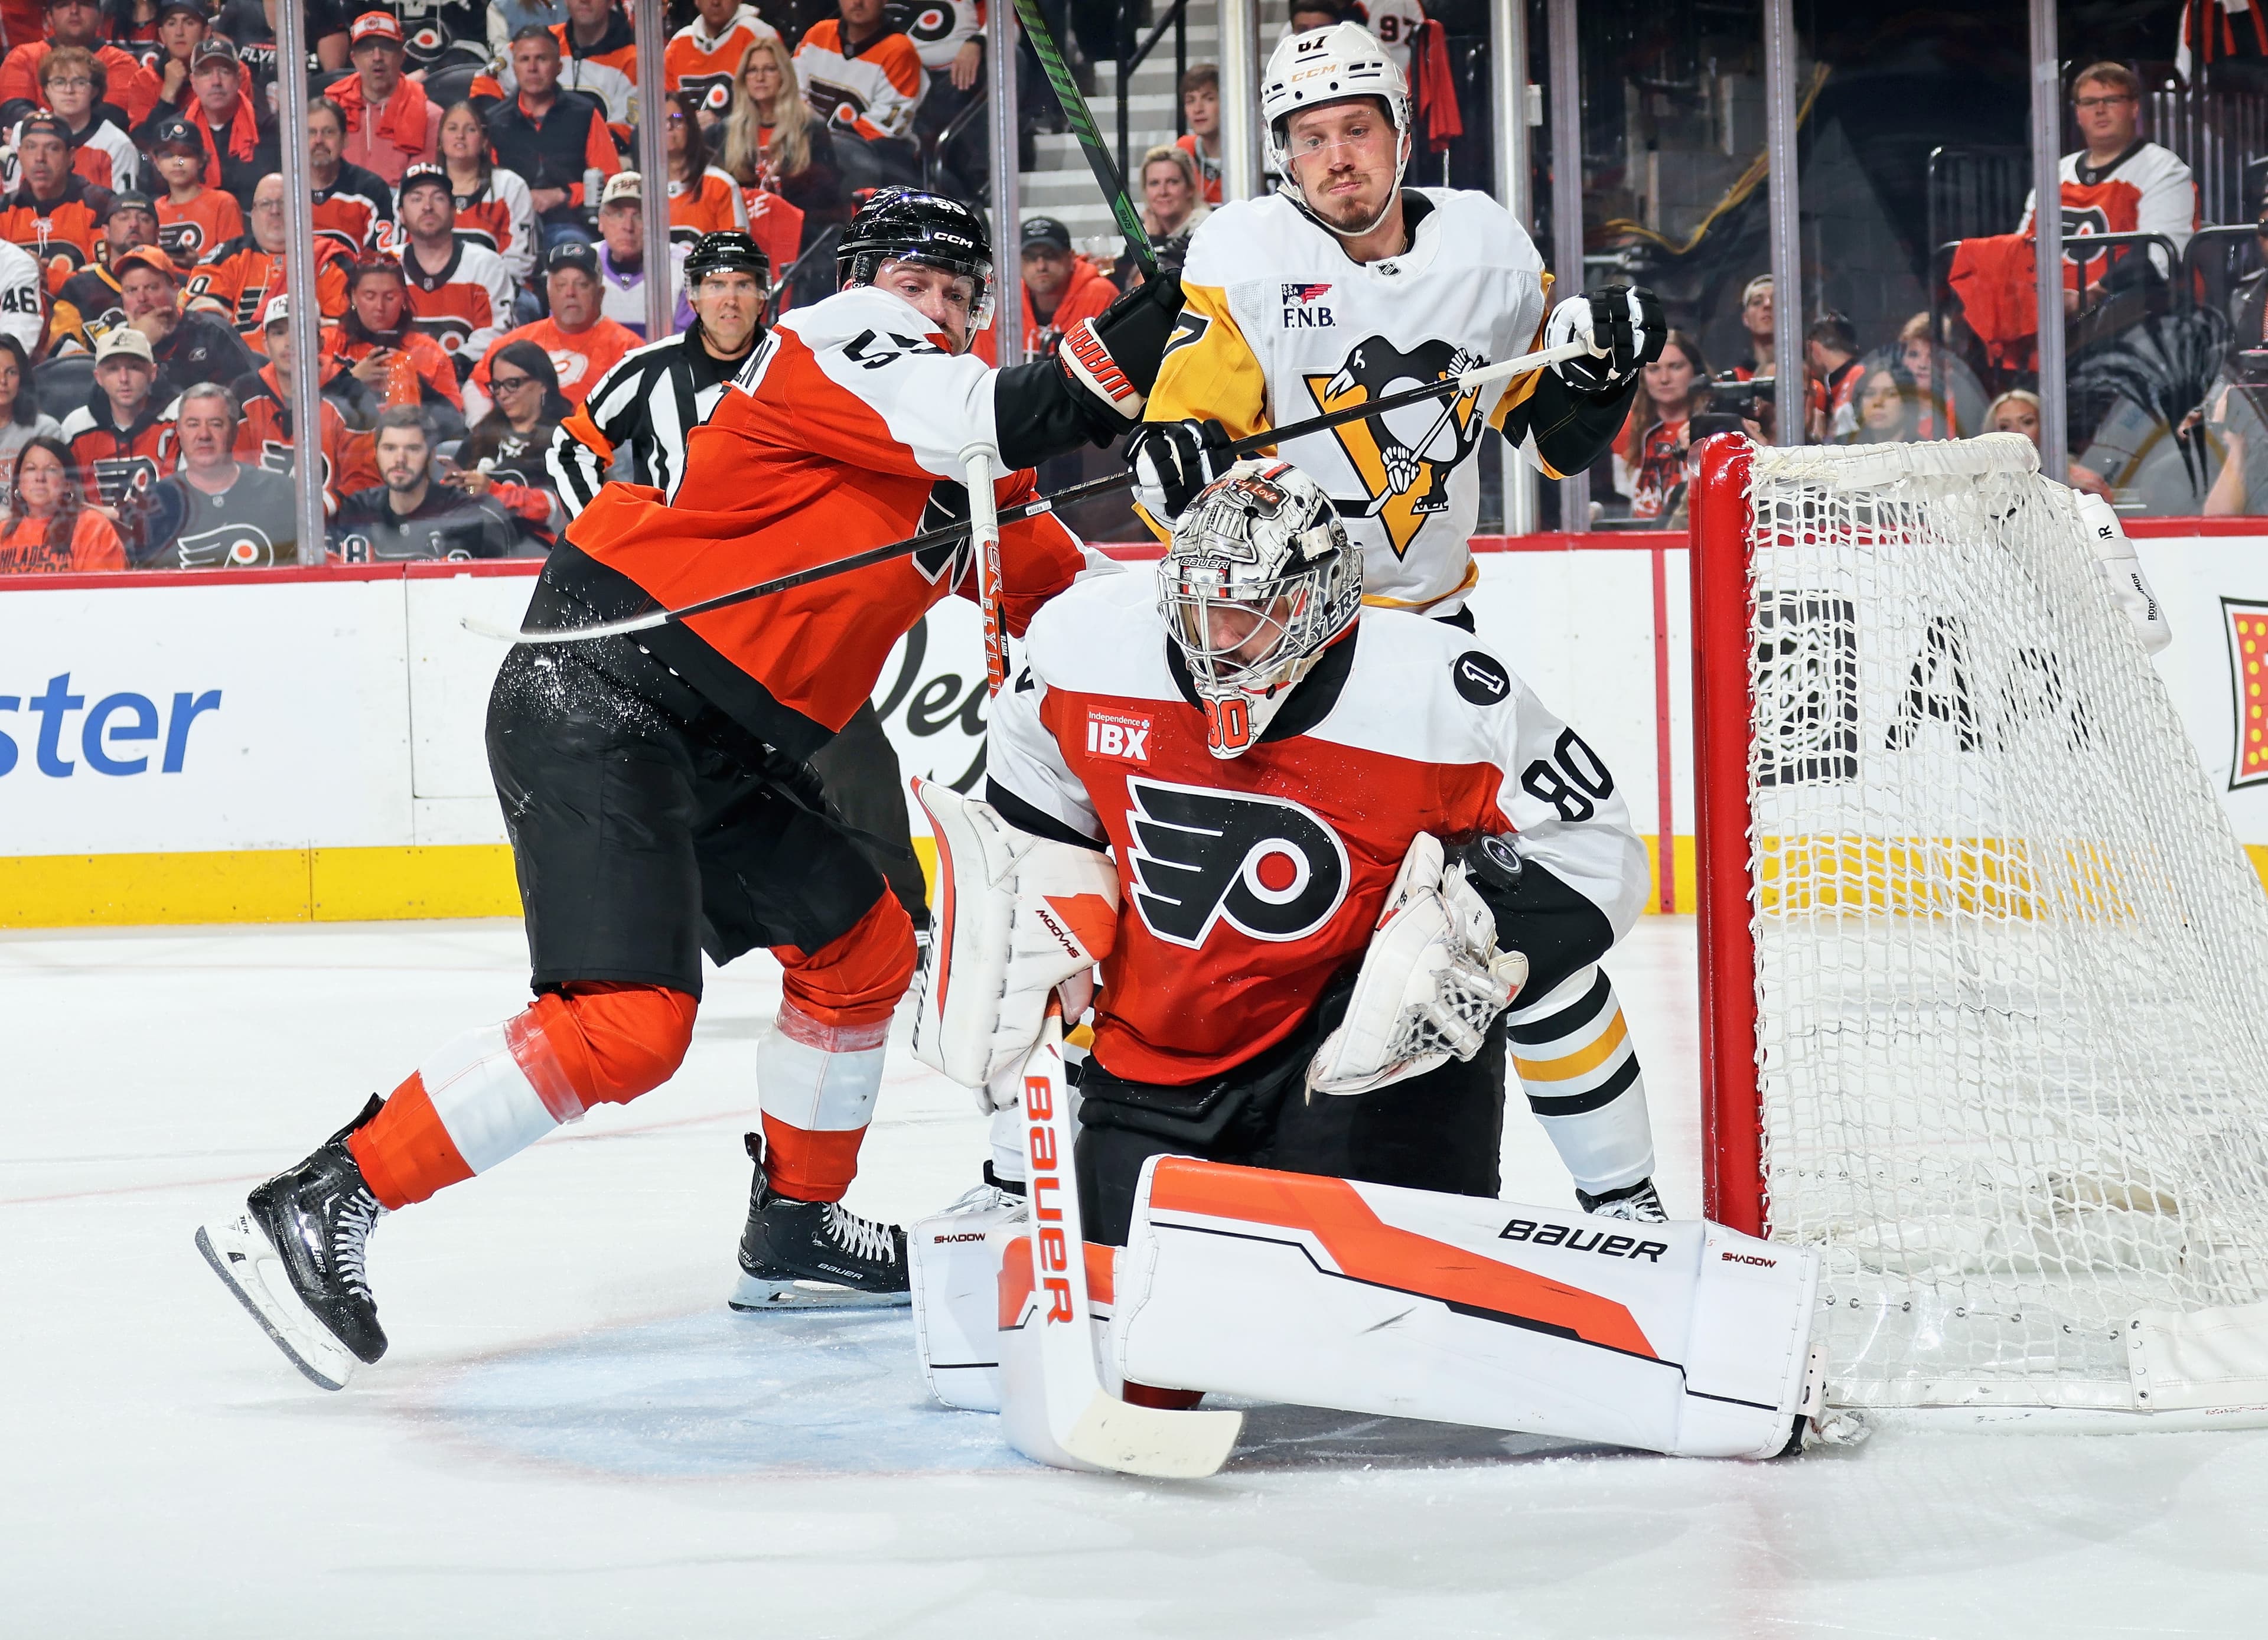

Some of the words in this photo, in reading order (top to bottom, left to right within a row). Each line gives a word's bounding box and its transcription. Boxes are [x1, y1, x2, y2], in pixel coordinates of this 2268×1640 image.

[1291, 64, 1338, 83] CCM
[933, 231, 975, 249] CCM
[1, 286, 38, 314] 46
[1283, 307, 1336, 328] F.N.B.
[1179, 556, 1231, 570] BAUER
[1461, 660, 1506, 695] 1
[1088, 710, 1140, 726] Independence
[1087, 721, 1149, 761] IBX
[1520, 726, 1615, 823] 80
[1035, 909, 1080, 958] SHADOW
[1024, 1075, 1074, 1327] BAUER
[933, 1232, 986, 1244] SHADOW
[1497, 1218, 1669, 1264] BAUER
[1721, 1251, 1777, 1269] SHADOW
[817, 1262, 865, 1281] BAUER
